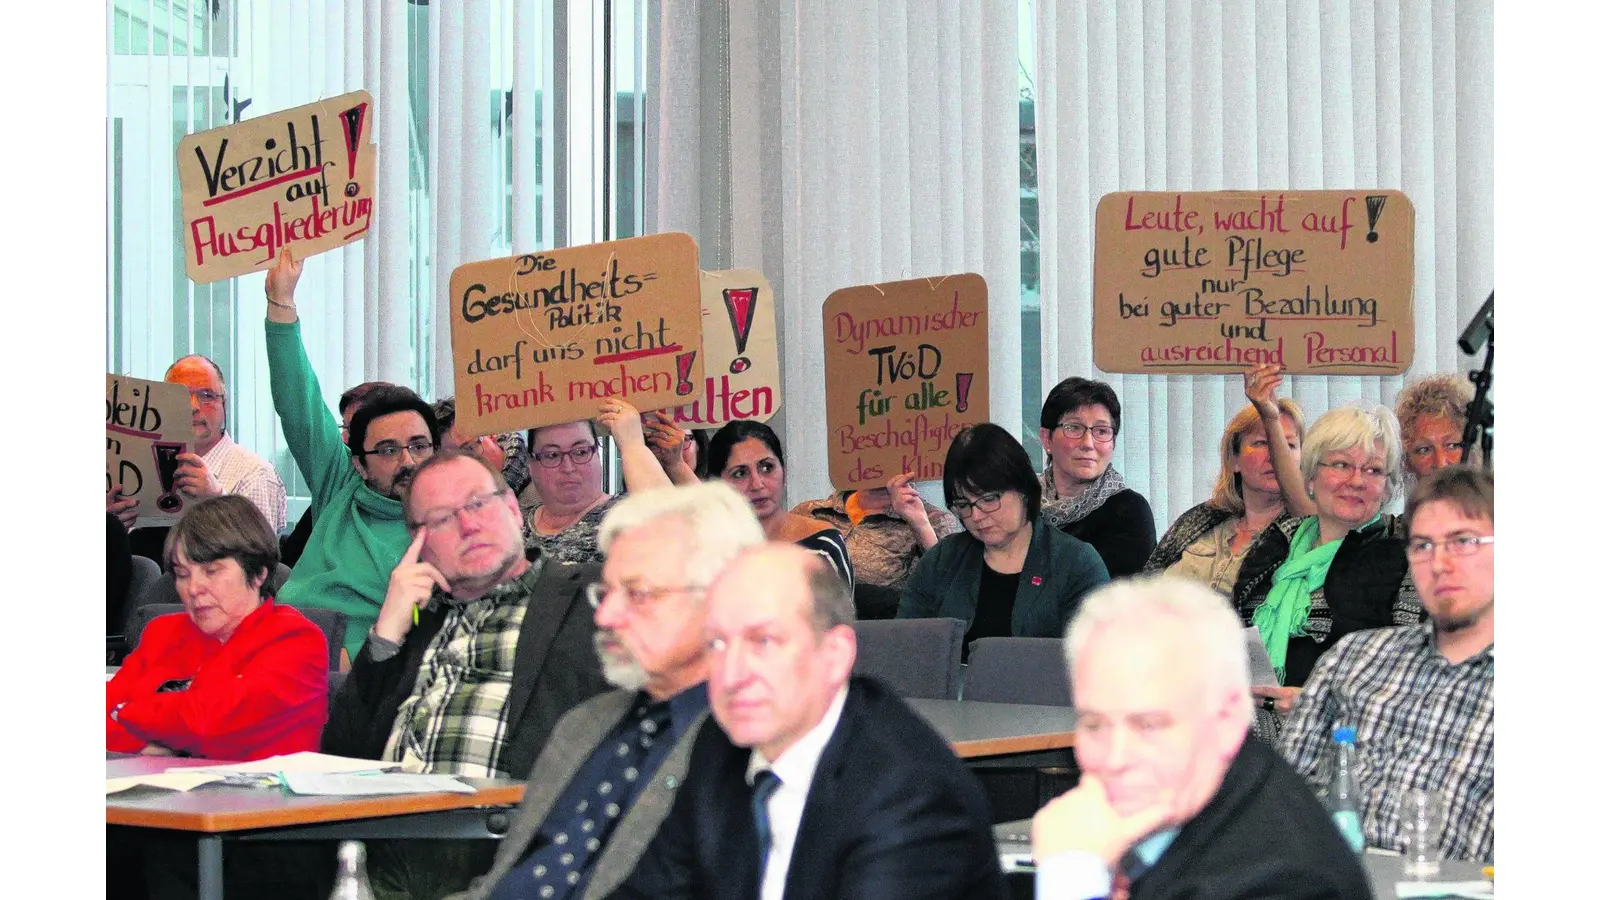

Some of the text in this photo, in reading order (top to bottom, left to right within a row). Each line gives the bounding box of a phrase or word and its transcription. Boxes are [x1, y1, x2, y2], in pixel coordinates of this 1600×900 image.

[195, 115, 329, 198] Verzicht
[286, 161, 336, 206] auf
[190, 195, 373, 266] Ausgliederung
[1124, 195, 1204, 235] Leute,
[1214, 195, 1291, 233] wacht
[1301, 197, 1356, 250] auf
[515, 254, 558, 276] Die
[1141, 235, 1307, 280] gute Pflege
[1119, 284, 1386, 327] bei guter Bezahlung
[1202, 277, 1247, 294] nur
[544, 299, 622, 332] Politik
[832, 290, 983, 354] Dynamischer
[1220, 318, 1274, 342] und
[467, 317, 677, 379] darf uns nicht
[868, 343, 942, 386] TVöD
[1140, 330, 1404, 367] ausreichend Personal
[475, 371, 554, 417] krank
[640, 375, 773, 424] alten
[856, 388, 897, 426] für
[848, 457, 884, 483] des
